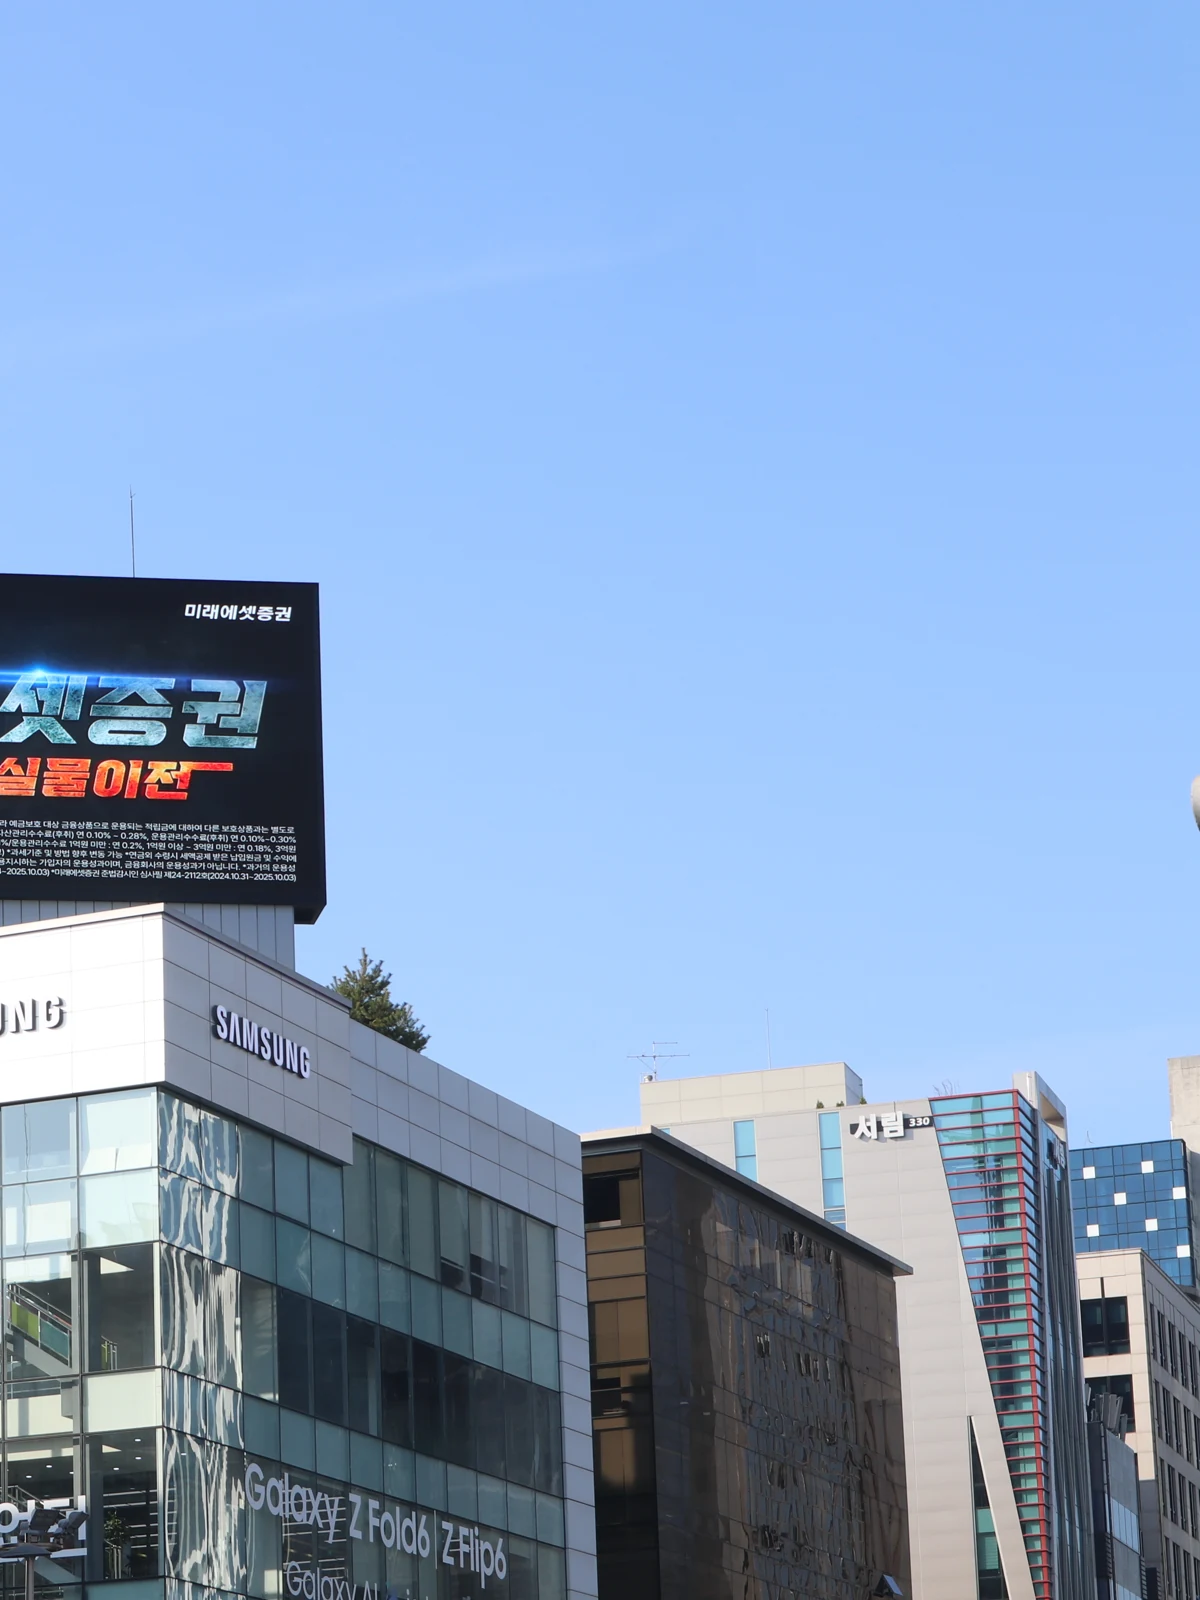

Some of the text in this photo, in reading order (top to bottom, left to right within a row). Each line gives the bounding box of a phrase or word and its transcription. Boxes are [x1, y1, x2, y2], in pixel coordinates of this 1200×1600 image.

[184, 604, 292, 622] 미래에셋증권
[8, 819, 41, 828] 예금보호
[42, 820, 59, 828] 대상
[61, 821, 109, 829] 금융상품으로
[110, 822, 143, 830] 운용되는
[144, 822, 176, 831] 적립금에
[178, 823, 202, 832] 대하여
[203, 824, 219, 832] 다른
[221, 824, 269, 833] 보호상품과는
[270, 825, 294, 834] 별도로
[75, 830, 84, 839] 연
[85, 831, 111, 839] 0.10%
[120, 831, 149, 840] 0.28%,
[229, 834, 238, 842] 연
[68, 840, 88, 848] 1억원
[89, 840, 106, 848] 미만
[111, 841, 120, 849] 연
[121, 841, 144, 849] 0.2%,
[146, 842, 165, 850] 1억원
[167, 842, 183, 850] 이상
[192, 843, 213, 851] 3억원
[215, 843, 231, 851] 미만
[236, 844, 245, 852] 연
[246, 844, 273, 852] 0.18%,
[274, 845, 296, 853] 3억원
[43, 849, 52, 857] 및
[53, 849, 69, 857] 방법
[88, 850, 105, 858] 변동
[107, 850, 122, 858] 가능
[154, 851, 178, 860] 수령시
[179, 852, 211, 861] 세액공제
[212, 853, 228, 861] 받은
[262, 854, 271, 862] 및
[272, 854, 297, 862] 수익에
[39, 858, 70, 867] 가입자의
[72, 859, 122, 868] 운용성과이며,
[124, 860, 164, 869] 금융회사의
[165, 861, 205, 870] 운용성과가
[206, 862, 240, 871] 아닙니다.
[272, 864, 295, 872] 운용성
[100, 869, 138, 878] 준법감시인
[213, 1004, 310, 1079] SAMSUNG
[853, 1111, 930, 1140] 서림 330
[245, 1463, 507, 1589] Galaxy Z Fold6 Z Flip6
[286, 1560, 357, 1600] Galaxy
